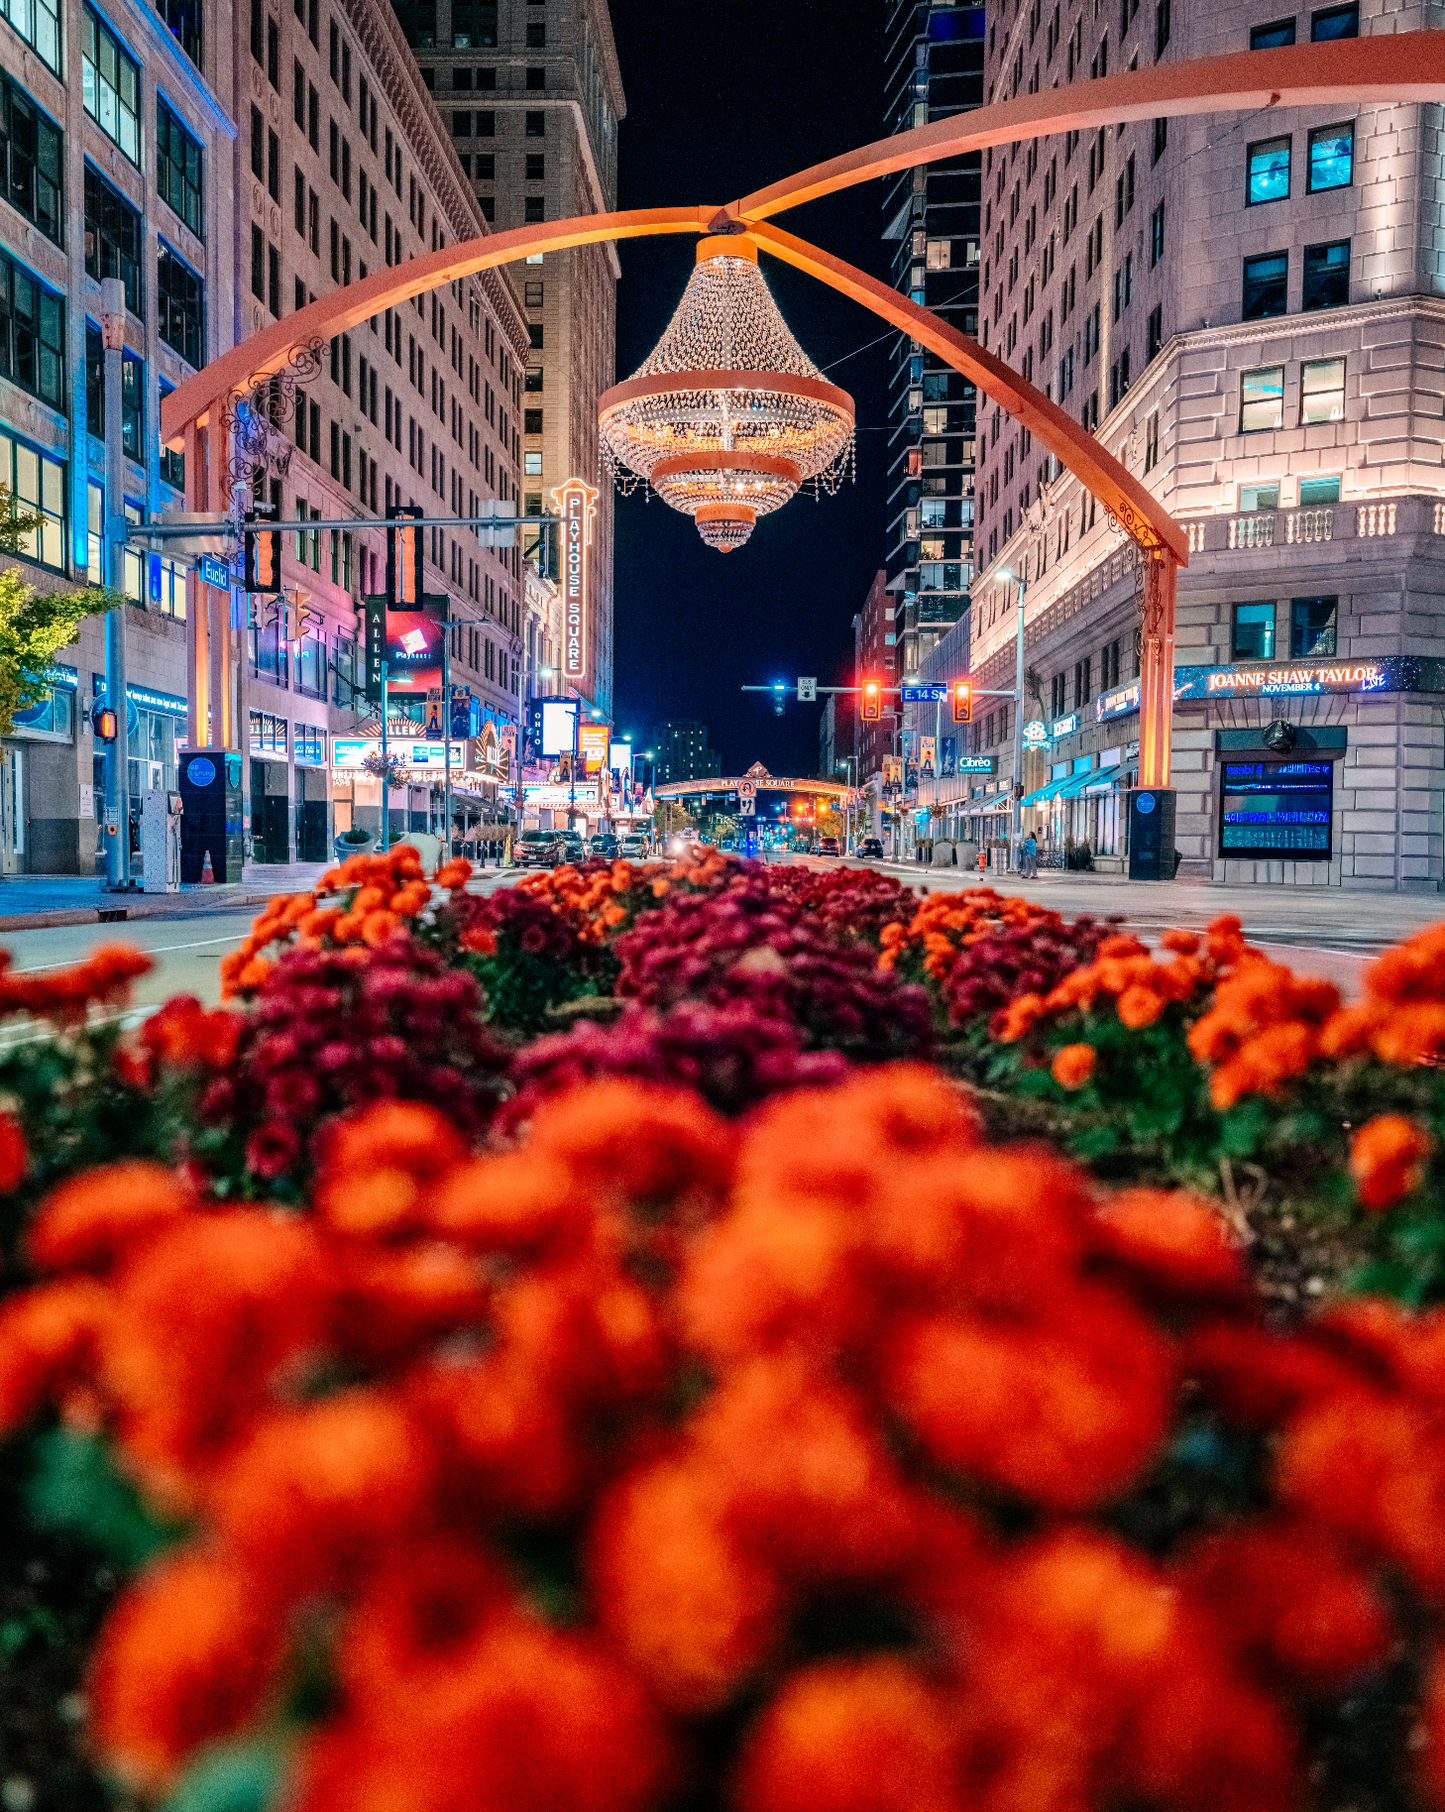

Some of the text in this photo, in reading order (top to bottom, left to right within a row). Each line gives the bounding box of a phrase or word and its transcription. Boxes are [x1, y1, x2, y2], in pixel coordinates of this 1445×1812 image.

[206, 561, 226, 586] Euclid
[569, 498, 580, 671] PLAYHOUSE SQUARE
[372, 613, 381, 683] ALLEN
[1209, 673, 1265, 690] JOANNE
[1268, 670, 1313, 684] SHAW
[1316, 667, 1377, 682] TAYLOR
[905, 690, 914, 699] E.
[917, 690, 928, 699] 14
[1262, 682, 1320, 692] NOVEMBER 4
[960, 757, 991, 767] Cibrèo
[765, 780, 795, 788] SQUARE
